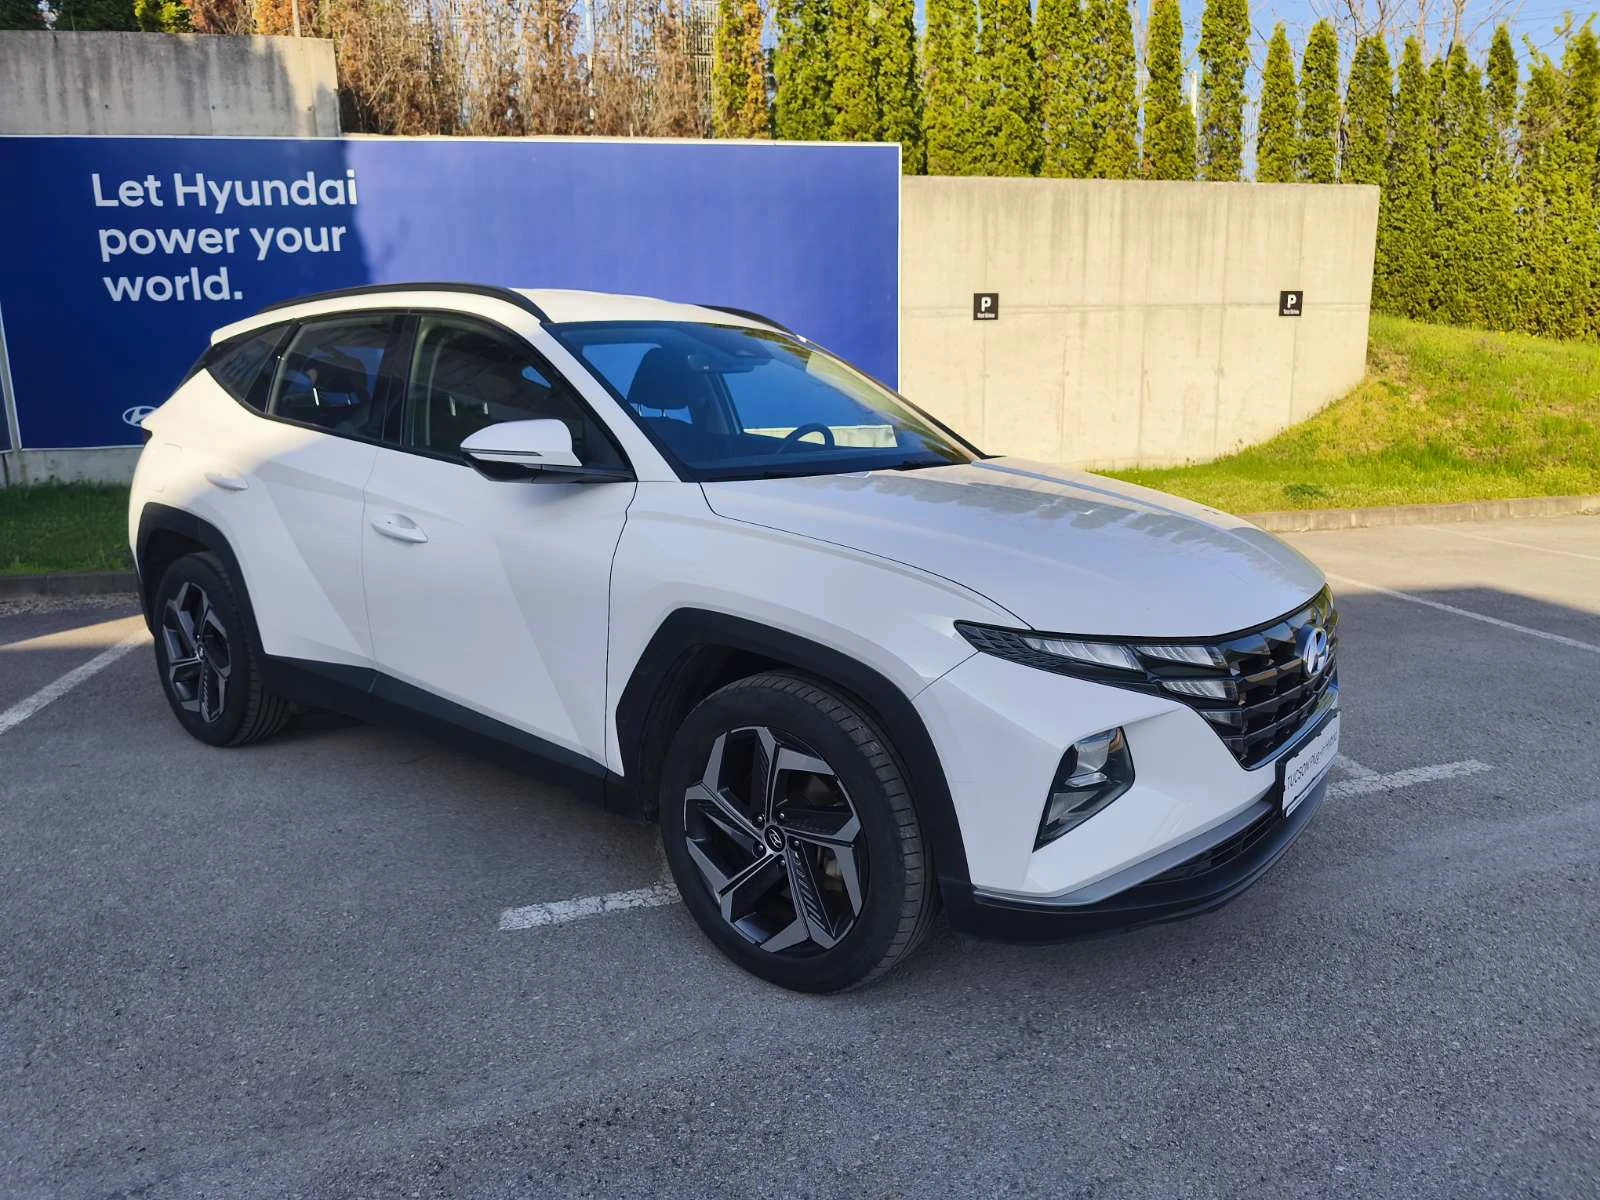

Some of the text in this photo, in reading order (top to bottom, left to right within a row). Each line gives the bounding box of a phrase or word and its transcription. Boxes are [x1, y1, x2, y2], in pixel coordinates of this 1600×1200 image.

[91, 169, 358, 214] Let Hyundai
[98, 225, 347, 262] power your
[102, 267, 243, 302] world.
[1287, 294, 1296, 308] P
[981, 297, 991, 312] P
